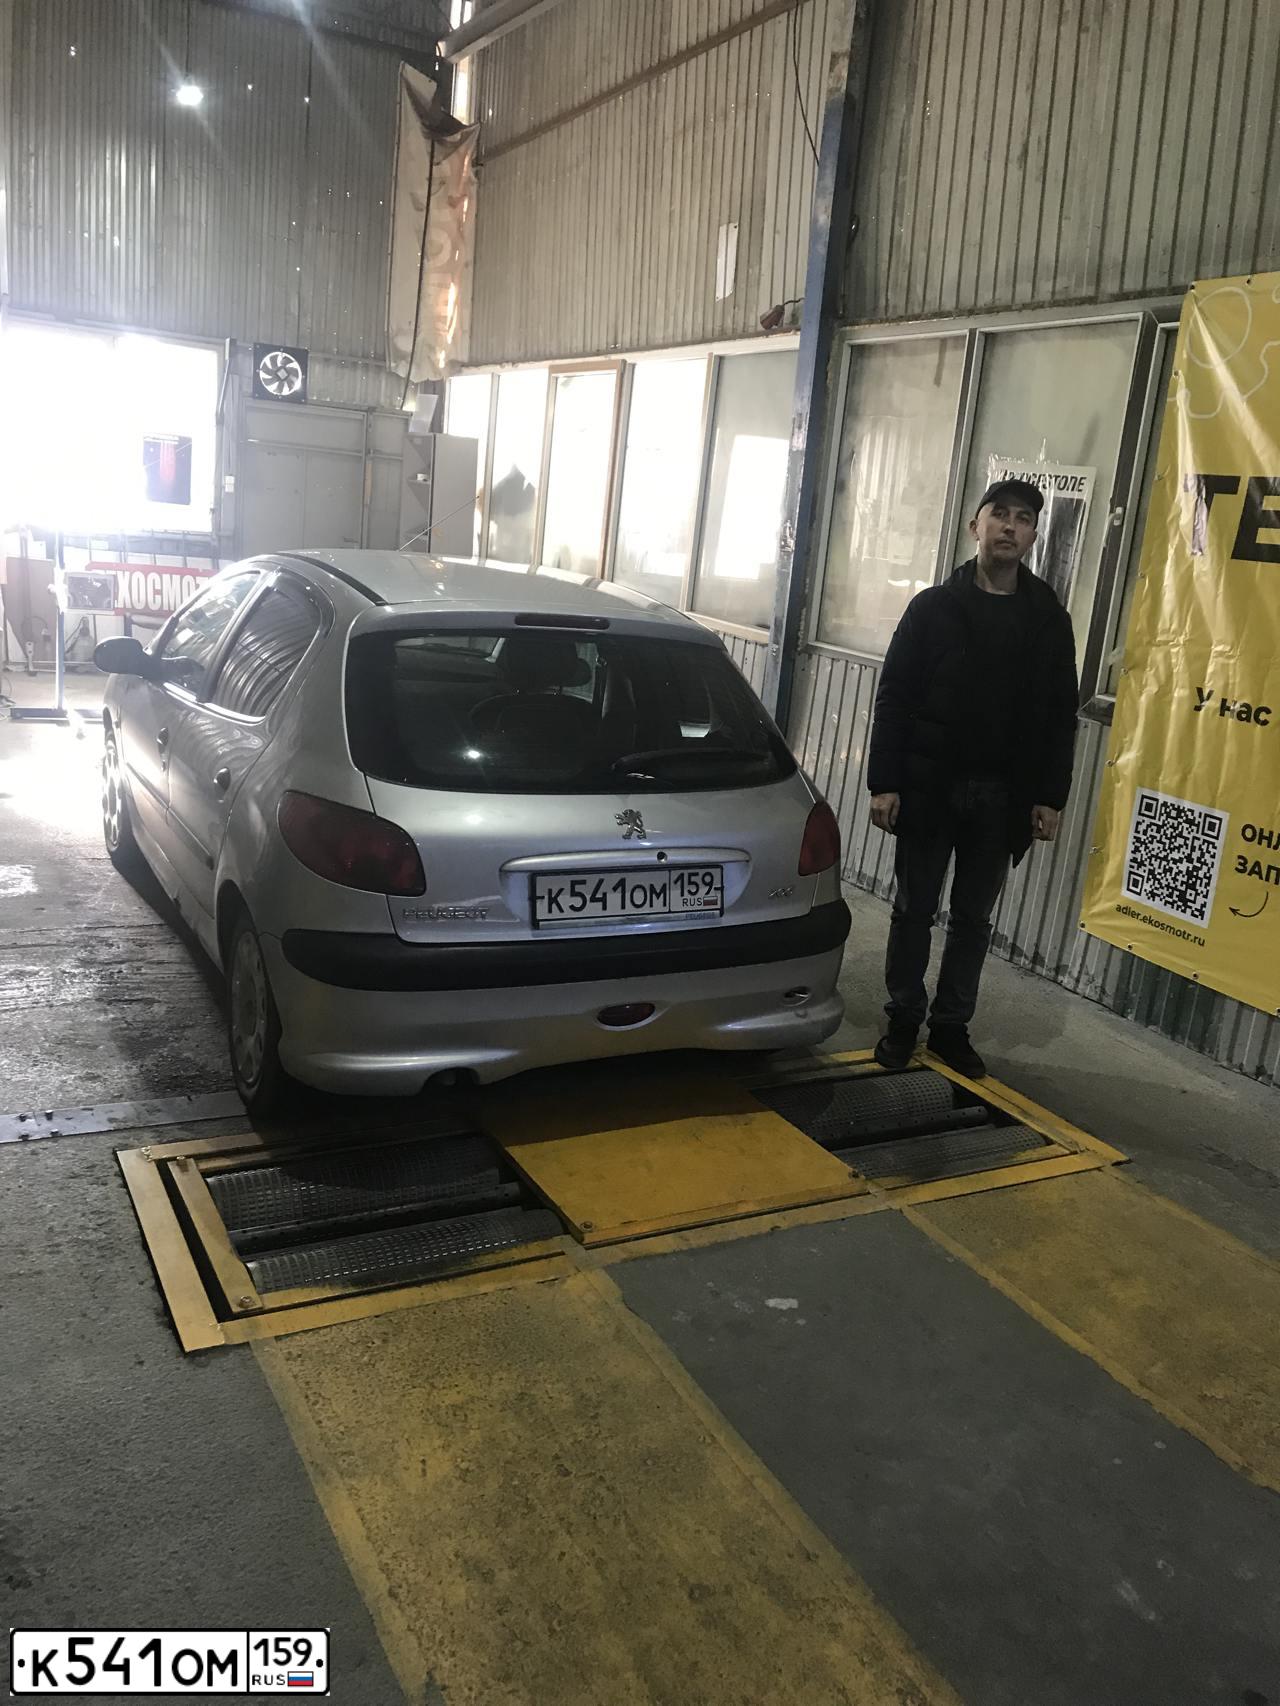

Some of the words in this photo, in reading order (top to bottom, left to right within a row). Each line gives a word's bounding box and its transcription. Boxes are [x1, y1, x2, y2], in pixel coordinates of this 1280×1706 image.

[1219, 697, 1273, 726] нас
[547, 877, 667, 914] К541ОМ
[673, 871, 714, 897] 159
[682, 896, 703, 907] RUS
[1115, 904, 1206, 948] adler.ekosmotr.ru
